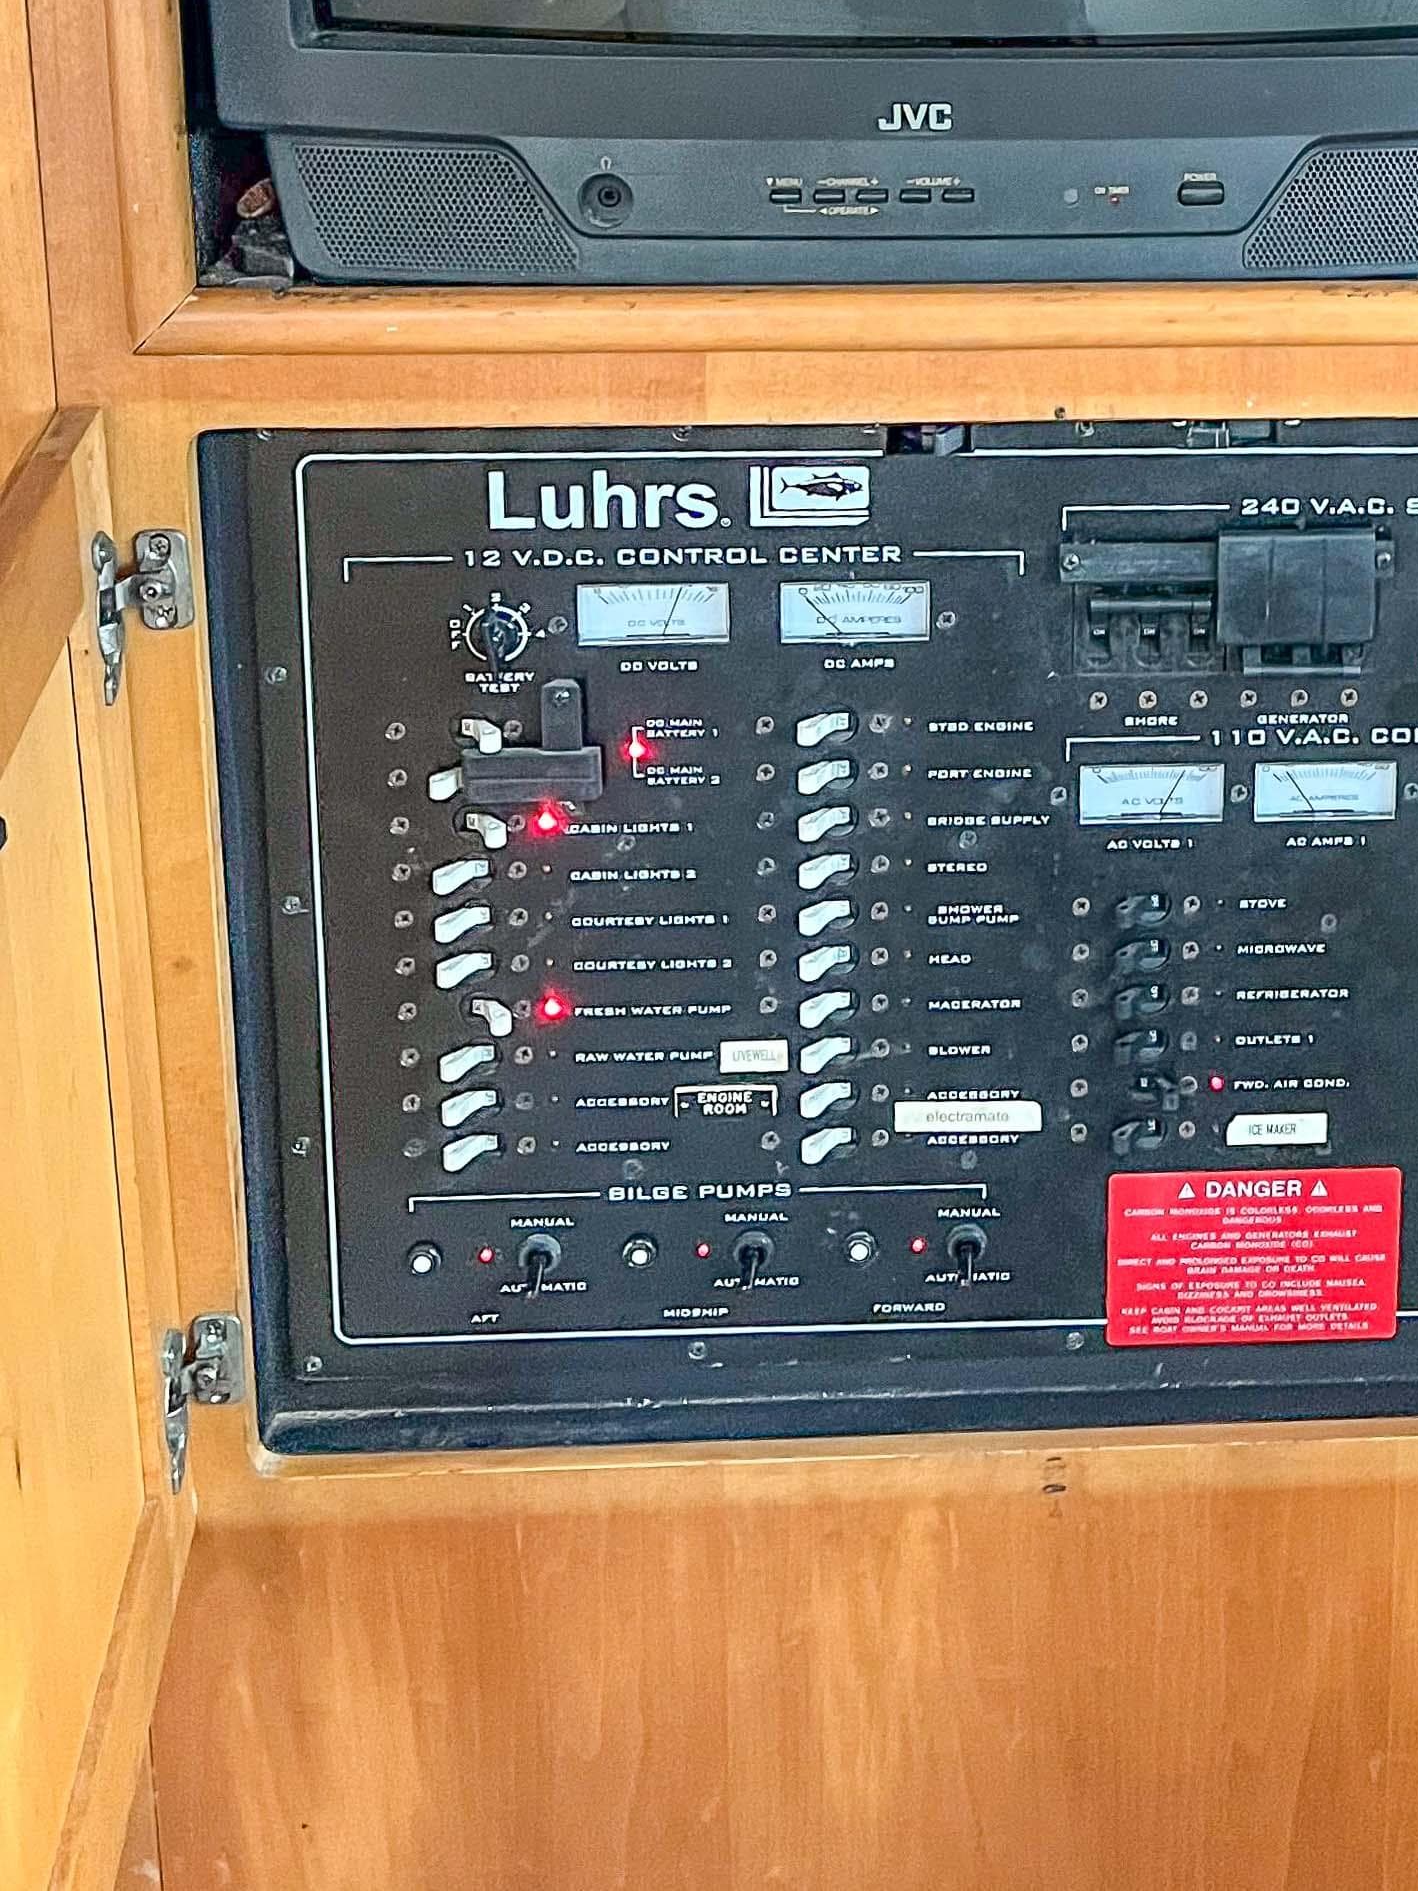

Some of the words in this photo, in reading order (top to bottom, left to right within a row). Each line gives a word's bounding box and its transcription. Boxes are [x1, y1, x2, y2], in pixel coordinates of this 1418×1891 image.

[878, 102, 953, 132] JVC
[1241, 497, 1300, 515] 240
[1310, 497, 1394, 515] V.A.C.
[464, 549, 501, 567] 12
[511, 549, 604, 566] V.D.C.
[616, 547, 768, 566] CONTROL
[779, 545, 901, 564] CENTER
[620, 661, 643, 672] DC
[647, 660, 698, 671] VOLTS
[823, 658, 846, 669] DC
[850, 658, 895, 669] AMPS
[479, 684, 520, 693] TEST
[645, 718, 665, 728] DC
[669, 718, 703, 728] MAIN
[1124, 715, 1178, 727] SHORE
[1256, 713, 1349, 725] GENERATOR
[928, 721, 969, 732] STBD
[974, 721, 1034, 732] ENGINE
[646, 728, 706, 738] BATTERY
[712, 728, 719, 737] 1
[1211, 728, 1265, 746] 110
[1275, 728, 1360, 746] V.A.C.
[646, 766, 665, 776] DC
[669, 766, 703, 776] MAIN
[927, 769, 970, 779] PORT
[972, 768, 1032, 779] ENGINE
[646, 775, 706, 786] BATTERY
[927, 815, 986, 826] BRIDGE
[990, 815, 1050, 825] SUPPLY
[569, 823, 618, 834] CABIN
[622, 823, 680, 833] LIGHTS
[686, 822, 693, 832] 1
[1106, 839, 1128, 850] AC
[1131, 839, 1181, 849] VOLTS
[1187, 838, 1193, 848] 1
[1286, 836, 1307, 847] AC
[1311, 836, 1354, 847] AMPS
[1360, 835, 1366, 846] 1
[927, 862, 988, 873] STEREO
[570, 871, 619, 881] CABIN
[623, 869, 681, 880] LIGHTS
[1239, 898, 1287, 909] STOVE
[937, 905, 1004, 915] SHOWER
[571, 916, 655, 927] COURTESY
[658, 914, 716, 926] LIGHTS
[722, 914, 730, 924] 1
[927, 914, 971, 925] SUMP
[974, 914, 1020, 925] PUMP
[1237, 943, 1326, 955] MICROWAVE
[573, 960, 656, 971] COURTESY
[660, 959, 717, 970] LIGHTS
[928, 954, 972, 965] HEAD
[1236, 988, 1349, 1000] REFRIGERATOR
[574, 1006, 626, 1017] FRESH
[630, 1005, 683, 1015] WATER
[687, 1004, 732, 1015] PUMP
[928, 999, 1021, 1010] MACERATOR
[1235, 1034, 1301, 1046] OUTLETS
[1308, 1034, 1314, 1044] 1
[575, 1052, 609, 1063] RAW
[613, 1051, 665, 1062] WATER
[669, 1050, 714, 1061] PUMP
[928, 1045, 991, 1056] BLOWER
[1273, 1079, 1299, 1089] AIR
[697, 1091, 753, 1104] ENGINE
[926, 1090, 1021, 1101] ACCESSORY
[575, 1096, 670, 1108] ACCESSORY
[702, 1103, 748, 1116] ROOM
[926, 1111, 1009, 1123] electramate
[1248, 1124, 1261, 1136] ICE
[1266, 1123, 1297, 1134] MAKER
[927, 1134, 1020, 1146] ACCESSORY
[575, 1141, 670, 1153] ACCESSORY
[608, 1185, 689, 1201] BILGE
[699, 1182, 792, 1199] PUMPS
[1205, 1180, 1302, 1198] DANGER
[724, 1212, 789, 1222] MANUAL
[937, 1207, 1001, 1218] MANUAL
[510, 1217, 575, 1228] MANUAL
[663, 1307, 729, 1318] MIDSHIP
[873, 1302, 946, 1313] FORWARD
[470, 1313, 500, 1324] AFT
